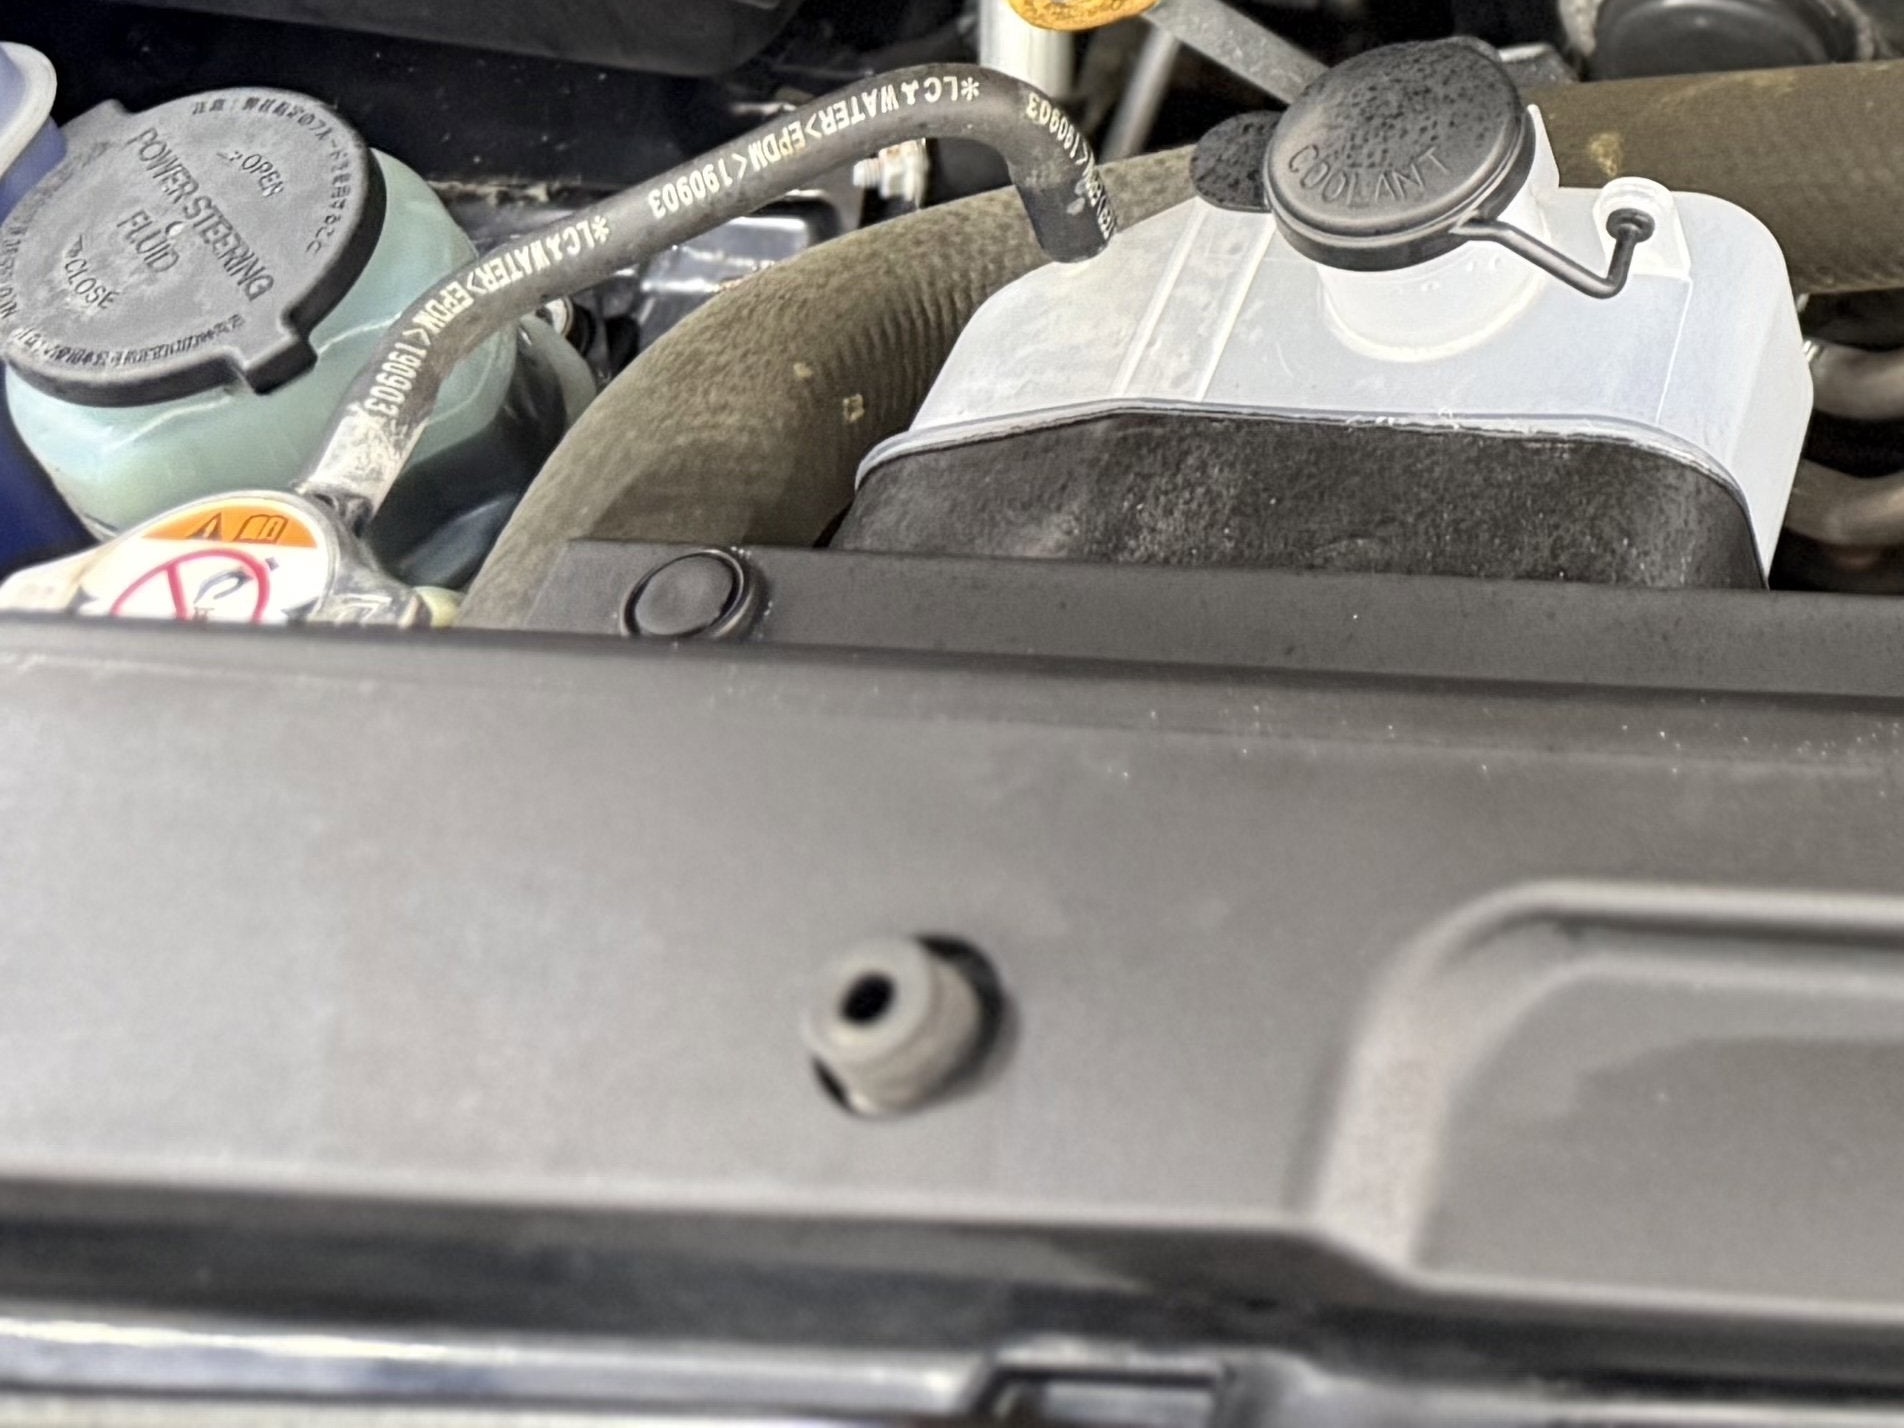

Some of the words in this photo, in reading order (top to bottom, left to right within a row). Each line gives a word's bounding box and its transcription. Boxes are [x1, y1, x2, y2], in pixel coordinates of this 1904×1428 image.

[238, 152, 286, 199] OPEN
[1288, 143, 1450, 209] COOLANT
[116, 209, 181, 274] FLUID
[125, 126, 200, 203] POWER
[182, 194, 275, 302] STEERING
[64, 255, 121, 311] CLOSE
